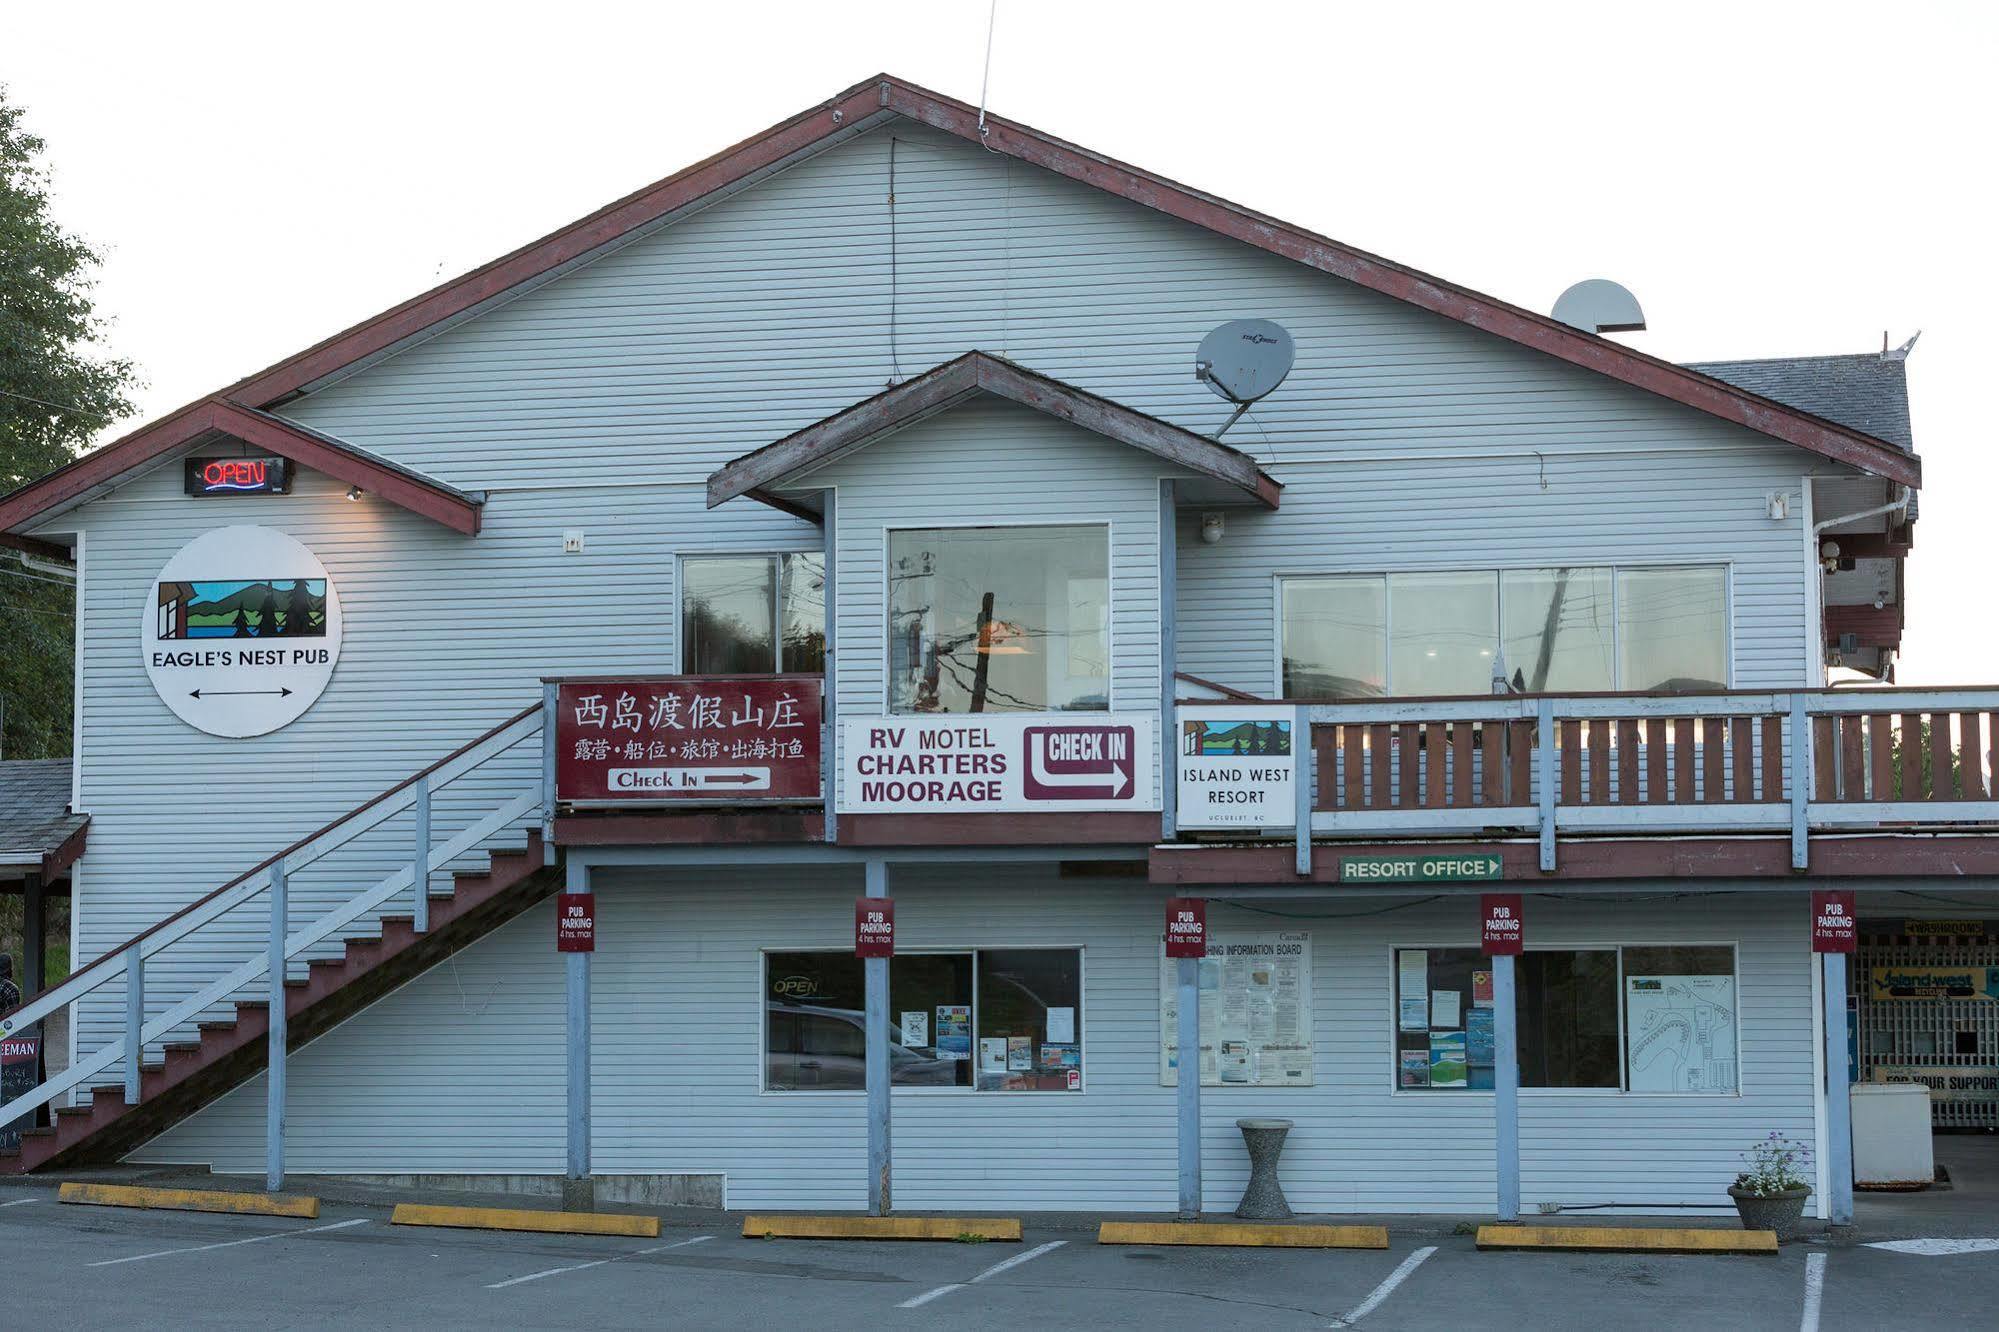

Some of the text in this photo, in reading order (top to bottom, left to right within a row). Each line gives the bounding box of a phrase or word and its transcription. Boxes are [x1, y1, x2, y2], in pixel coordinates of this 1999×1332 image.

[204, 460, 266, 484] OPEN
[152, 649, 329, 667] EAGLE'S NEST PUB
[574, 690, 805, 733] 西岛渡假山庄
[870, 728, 996, 750] RV MOTEL
[1048, 732, 1126, 761] CHECK IN
[857, 753, 1008, 775] CHARTERS
[1183, 769, 1290, 782] ISLAND WEST
[861, 781, 1003, 802] MOORAGE
[1208, 790, 1265, 804] RESORT
[1345, 860, 1485, 878] RESORT OFFICE
[568, 906, 584, 917] PUB
[1493, 907, 1510, 918] PUB
[1825, 903, 1843, 915] PUB
[867, 912, 883, 922] PUB
[1178, 911, 1194, 922] PUB
[1817, 916, 1852, 928] PARKING
[562, 917, 592, 929] PARKING
[860, 922, 892, 933] PARKING
[1170, 922, 1202, 933] PARKING
[1486, 919, 1520, 930] PARKING
[560, 930, 564, 938] 4
[858, 934, 863, 943] 4
[1168, 934, 1173, 943] 4
[1484, 931, 1489, 940] 4
[1503, 932, 1519, 940] max
[1815, 928, 1821, 937] 4
[1835, 930, 1852, 938] max
[1226, 944, 1274, 955] INFORMATION
[1276, 944, 1302, 955] BOARD
[774, 980, 818, 993] OPEN
[1949, 1076, 1999, 1090] SUPPOR
